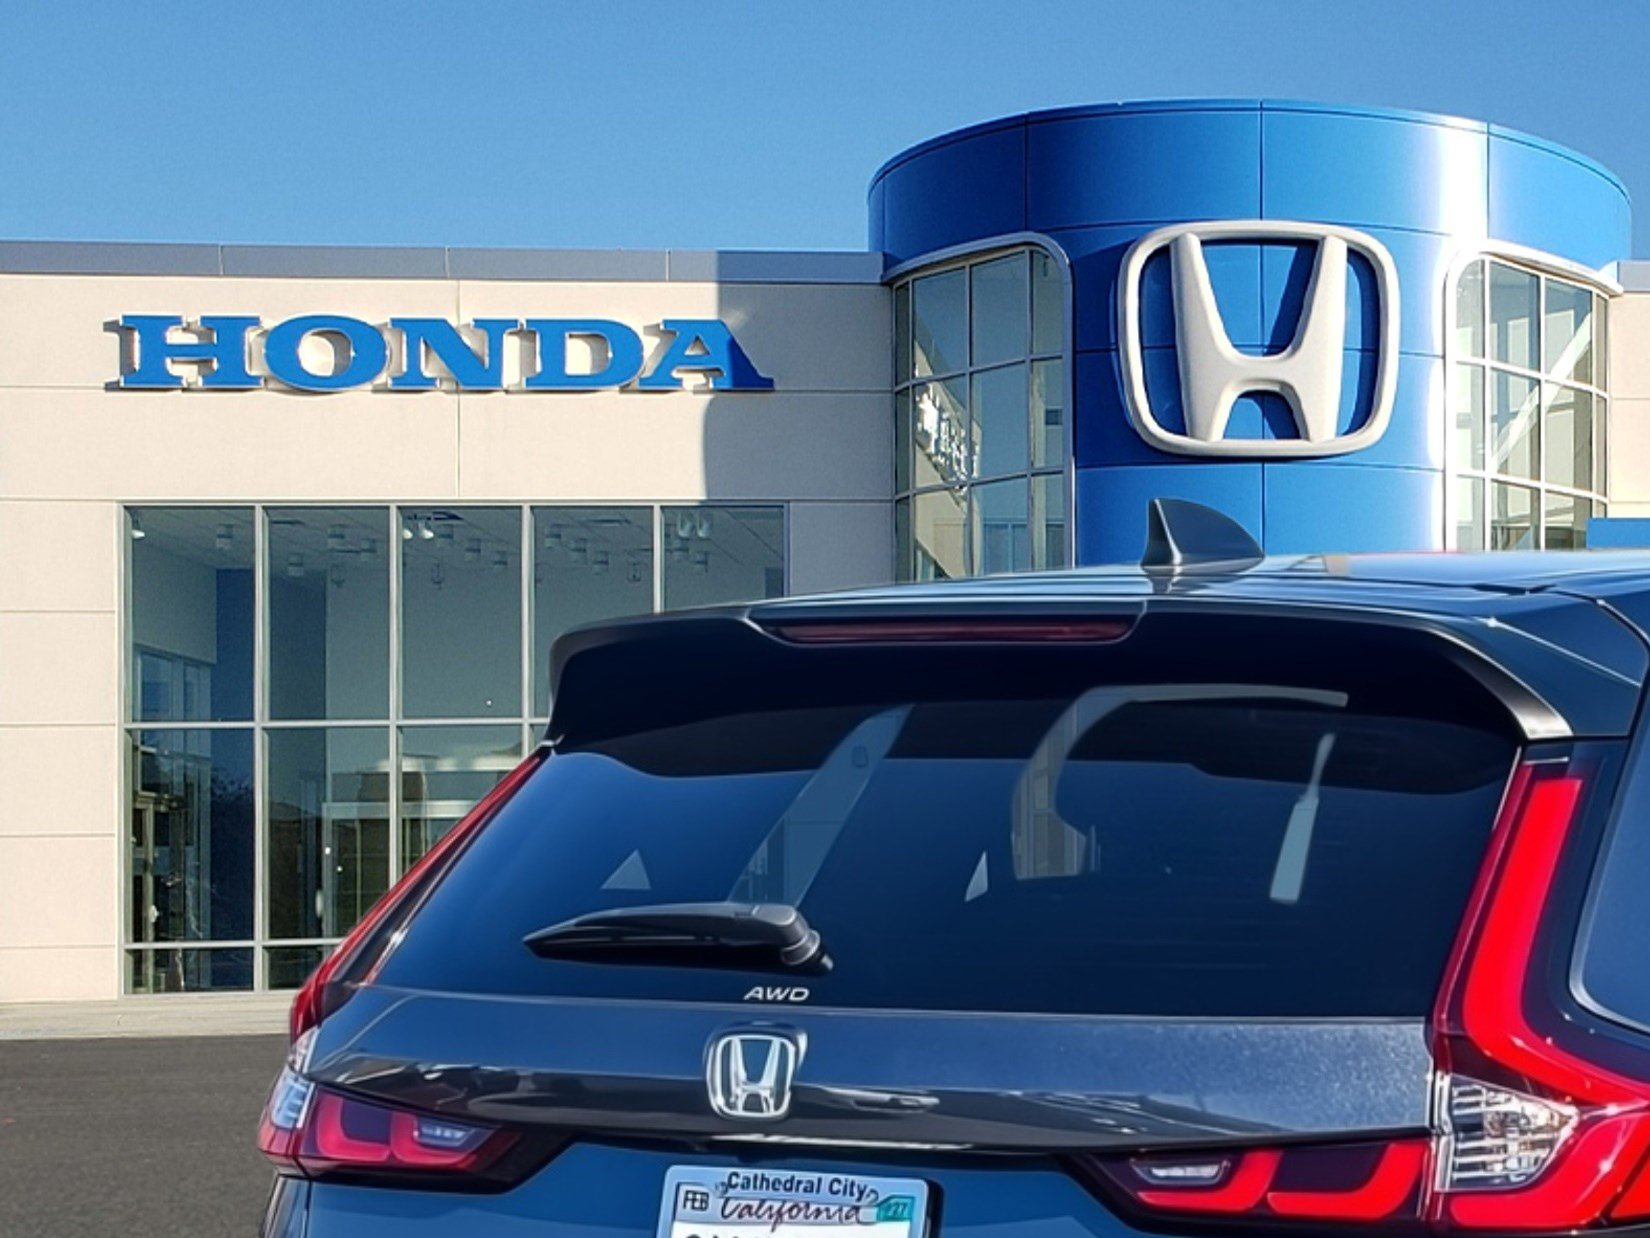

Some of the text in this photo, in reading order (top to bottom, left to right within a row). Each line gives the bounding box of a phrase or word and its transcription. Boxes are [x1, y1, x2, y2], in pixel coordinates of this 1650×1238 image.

[119, 313, 776, 391] HONDA
[743, 986, 810, 1001] AWD
[683, 1190, 710, 1211] FEB
[727, 1171, 869, 1203] Cathedral City
[721, 1197, 863, 1232] California
